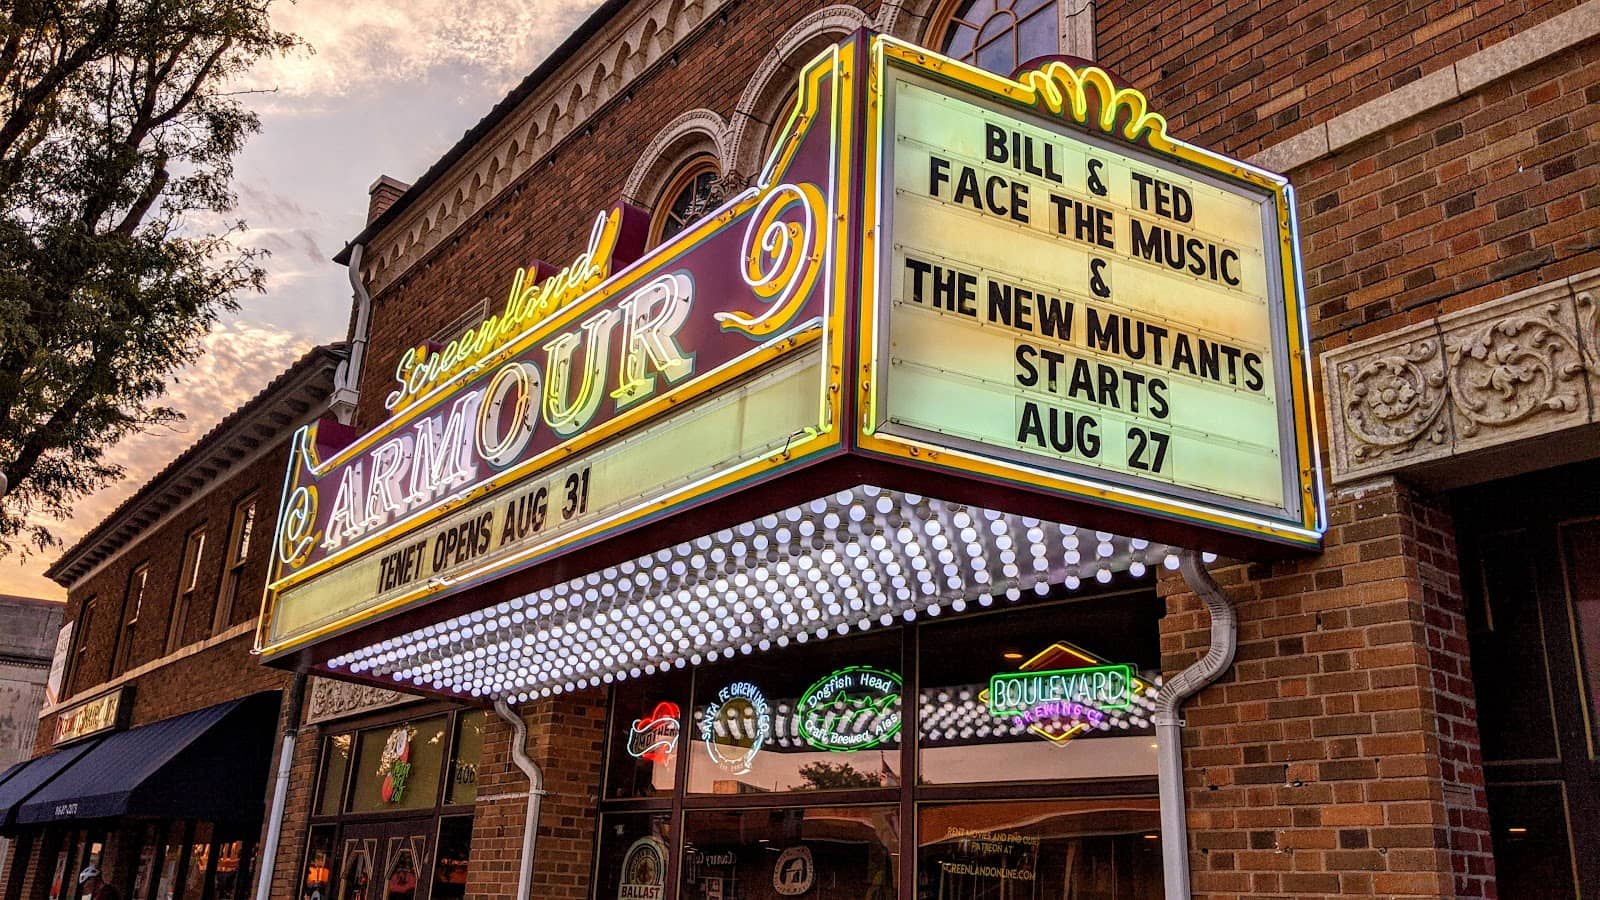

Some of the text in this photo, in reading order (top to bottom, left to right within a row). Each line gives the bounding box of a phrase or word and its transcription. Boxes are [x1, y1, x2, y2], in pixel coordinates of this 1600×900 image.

[984, 122, 1193, 223] BILL & TED
[929, 155, 1241, 287] FACE THE MUSIC
[385, 208, 621, 415] Screenland
[1089, 257, 1111, 298] &
[905, 258, 1264, 392] THE NEW MUTANTS
[320, 268, 697, 549] ARMOUR
[1015, 343, 1169, 420] STARTS
[1017, 402, 1171, 474] AUG 27
[377, 466, 592, 594] TENET OPENS AUG 31
[702, 702, 720, 740] SANTA
[719, 687, 730, 702] FE
[731, 682, 768, 714] BREWING
[807, 673, 892, 708] Dogfish Head
[994, 671, 1126, 708] BOULEVARD
[1013, 702, 1083, 727] BREWING
[805, 713, 898, 744] Craft Brewed Ales
[621, 886, 661, 899] BALLAST
